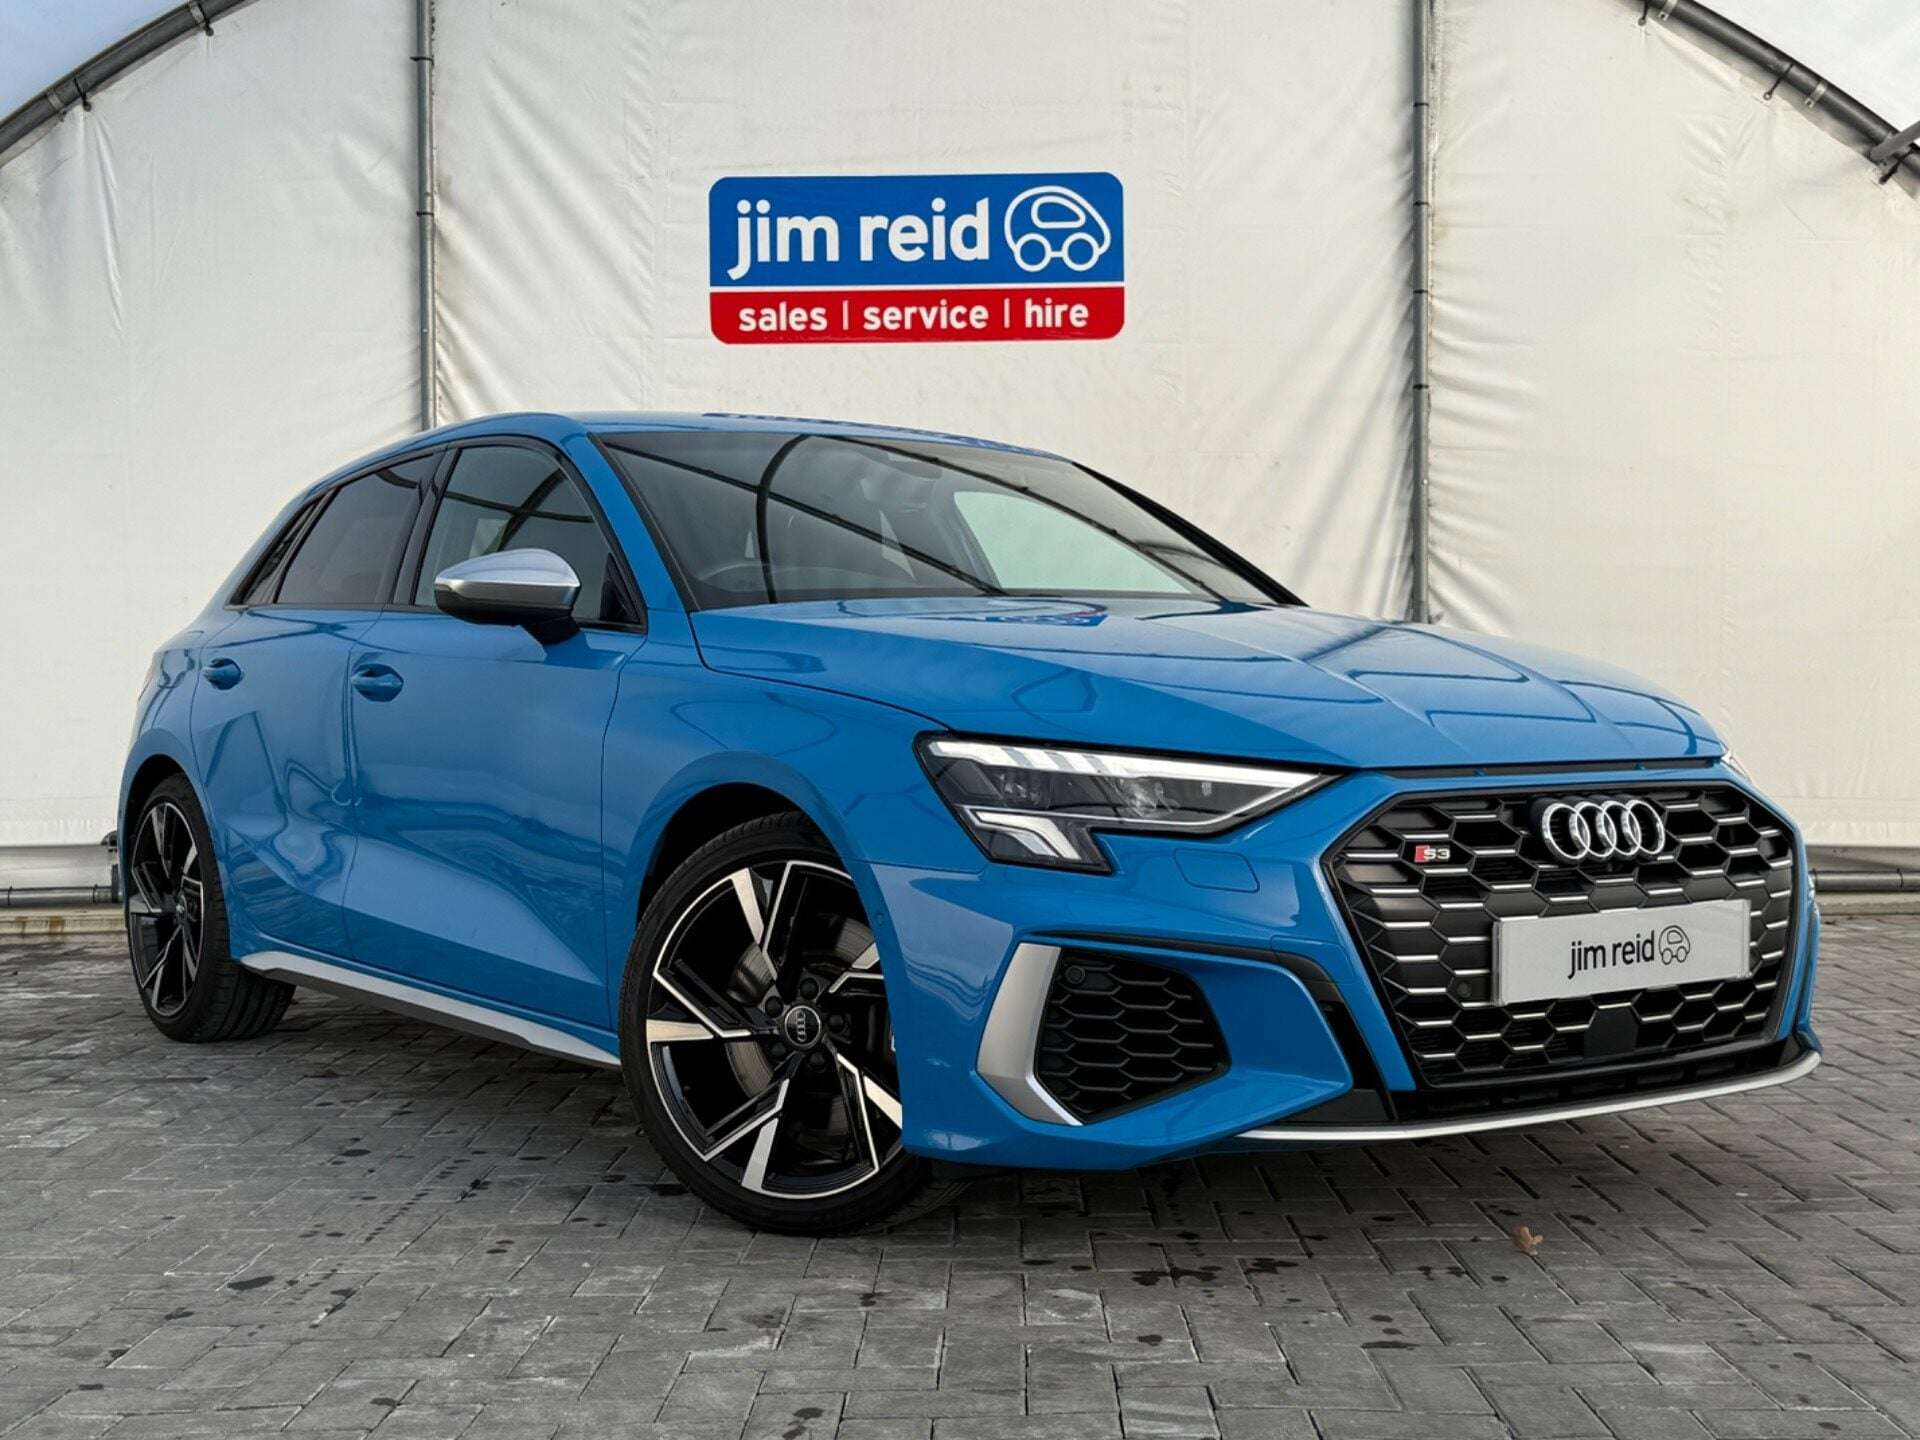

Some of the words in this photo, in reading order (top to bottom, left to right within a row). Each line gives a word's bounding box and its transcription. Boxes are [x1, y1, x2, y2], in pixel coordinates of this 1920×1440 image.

[727, 199, 840, 281] jim
[859, 197, 990, 262] reid
[738, 301, 829, 332] sales
[863, 299, 989, 331] service
[1025, 298, 1089, 328] hire
[1423, 848, 1451, 860] S3
[1567, 940, 1607, 980] jim
[1612, 929, 1655, 966] reid
